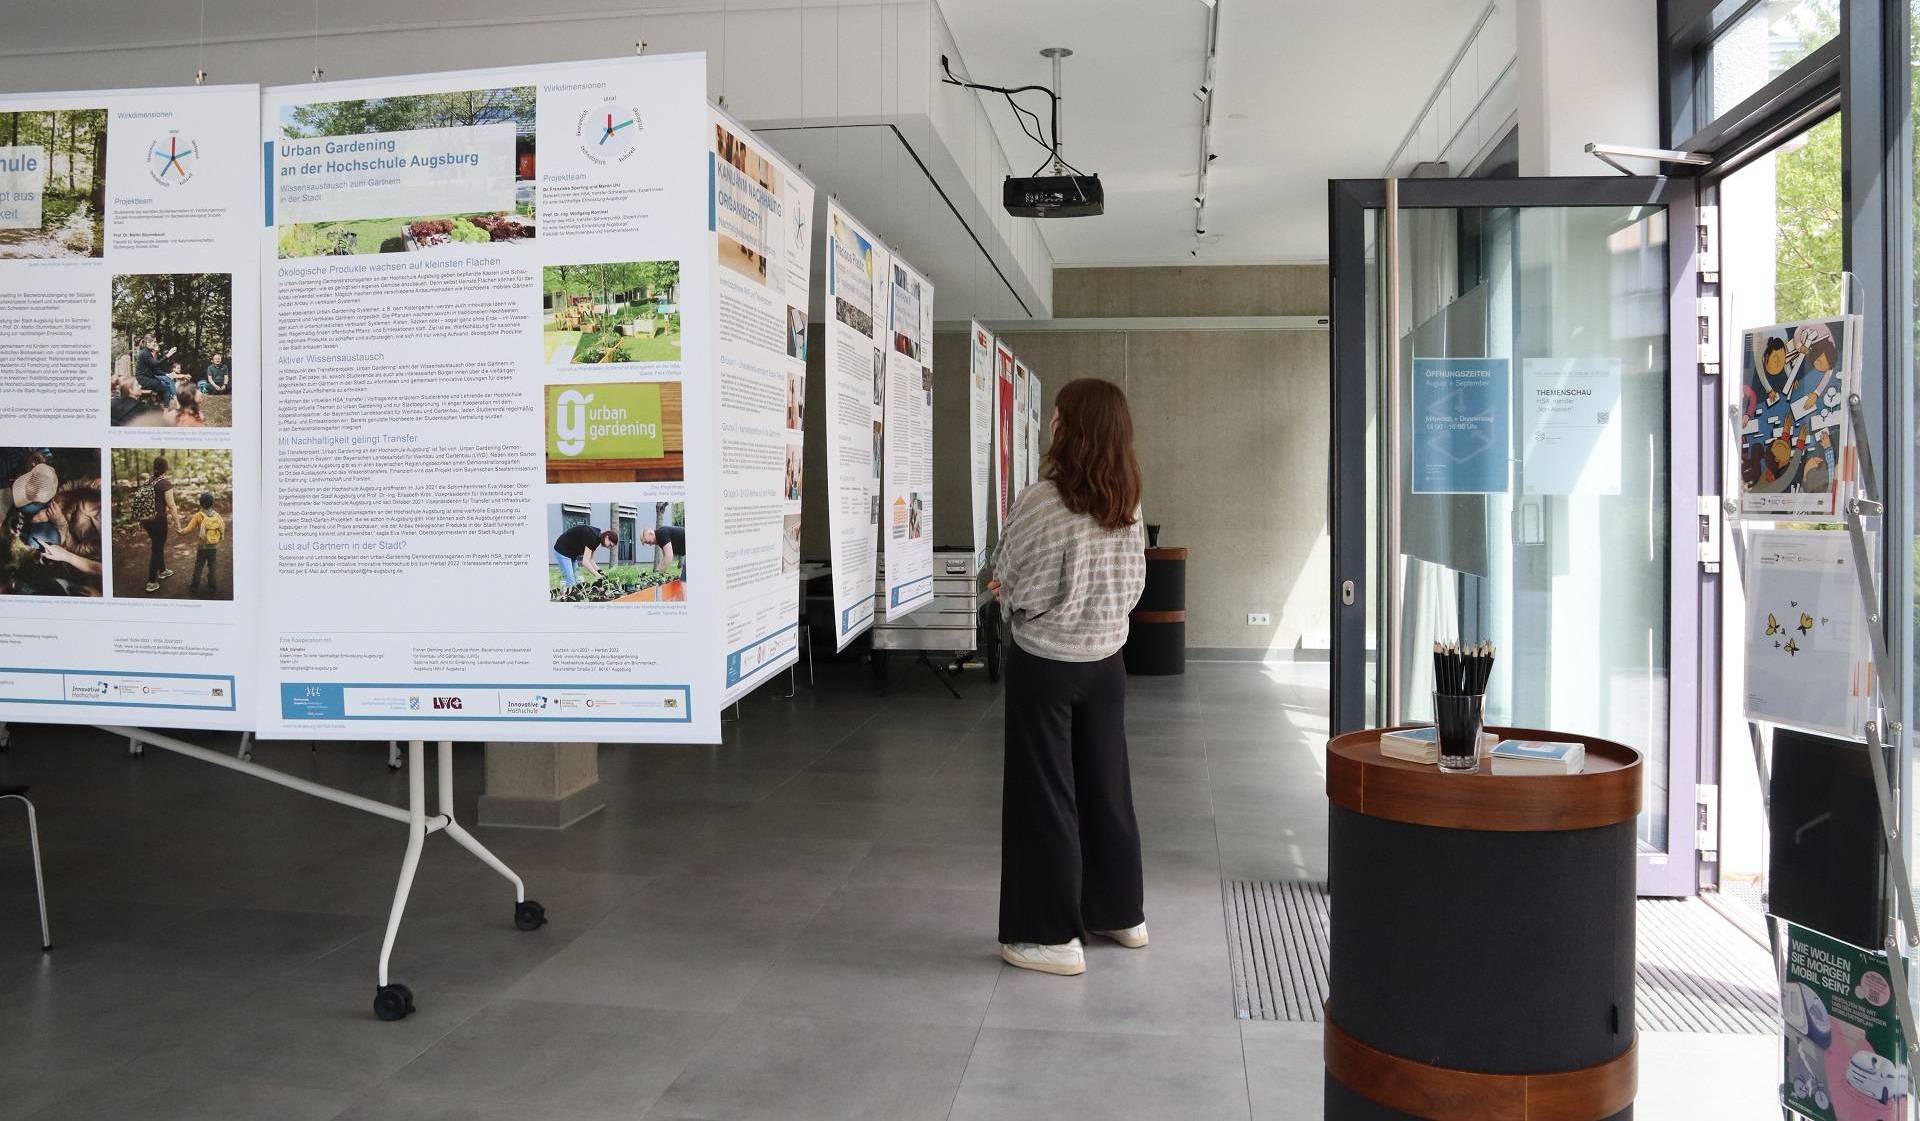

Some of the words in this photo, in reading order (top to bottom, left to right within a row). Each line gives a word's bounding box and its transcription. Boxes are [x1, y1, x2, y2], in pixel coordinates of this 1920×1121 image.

[281, 144, 321, 158] Urban
[326, 138, 396, 154] Gardening
[281, 166, 296, 176] an
[300, 162, 322, 175] der
[326, 156, 406, 173] Hochschule
[410, 151, 480, 168] Augsburg
[280, 182, 348, 194] Wissensaustausch
[14, 192, 34, 202] aus
[302, 194, 322, 202] Stadt
[278, 265, 326, 278] Ökologische
[330, 265, 367, 274] Produkte
[369, 264, 406, 272] wachsen
[409, 261, 422, 270] auf
[424, 260, 463, 269] kleinsten
[466, 258, 501, 267] Flächen
[278, 356, 304, 365] Aktiver
[306, 353, 384, 364] Wissensaustausch
[1425, 368, 1490, 378] ÖFFNUNGSZEITEN
[1456, 380, 1489, 388] September
[590, 405, 627, 421] urban
[1459, 415, 1494, 424] Donnerstag
[590, 422, 656, 440] gardening
[278, 437, 289, 446] Mit
[291, 436, 349, 446] Nachhaltigkeit
[352, 435, 380, 446] gelingt
[382, 434, 417, 443] Transfer
[278, 542, 295, 551] Lust
[296, 542, 310, 551] auf
[312, 541, 349, 550] Gärtnern
[352, 541, 360, 550] in
[362, 541, 376, 550] der
[379, 540, 407, 550] Stadt?
[433, 696, 463, 710] LWG
[1792, 939, 1809, 955] WIE
[1810, 947, 1850, 972] WOLLEN
[1792, 952, 1805, 965] SIE
[1807, 958, 1850, 984] MORGEN
[1792, 963, 1820, 985] MOBIL
[1822, 976, 1850, 996] SEIN?
